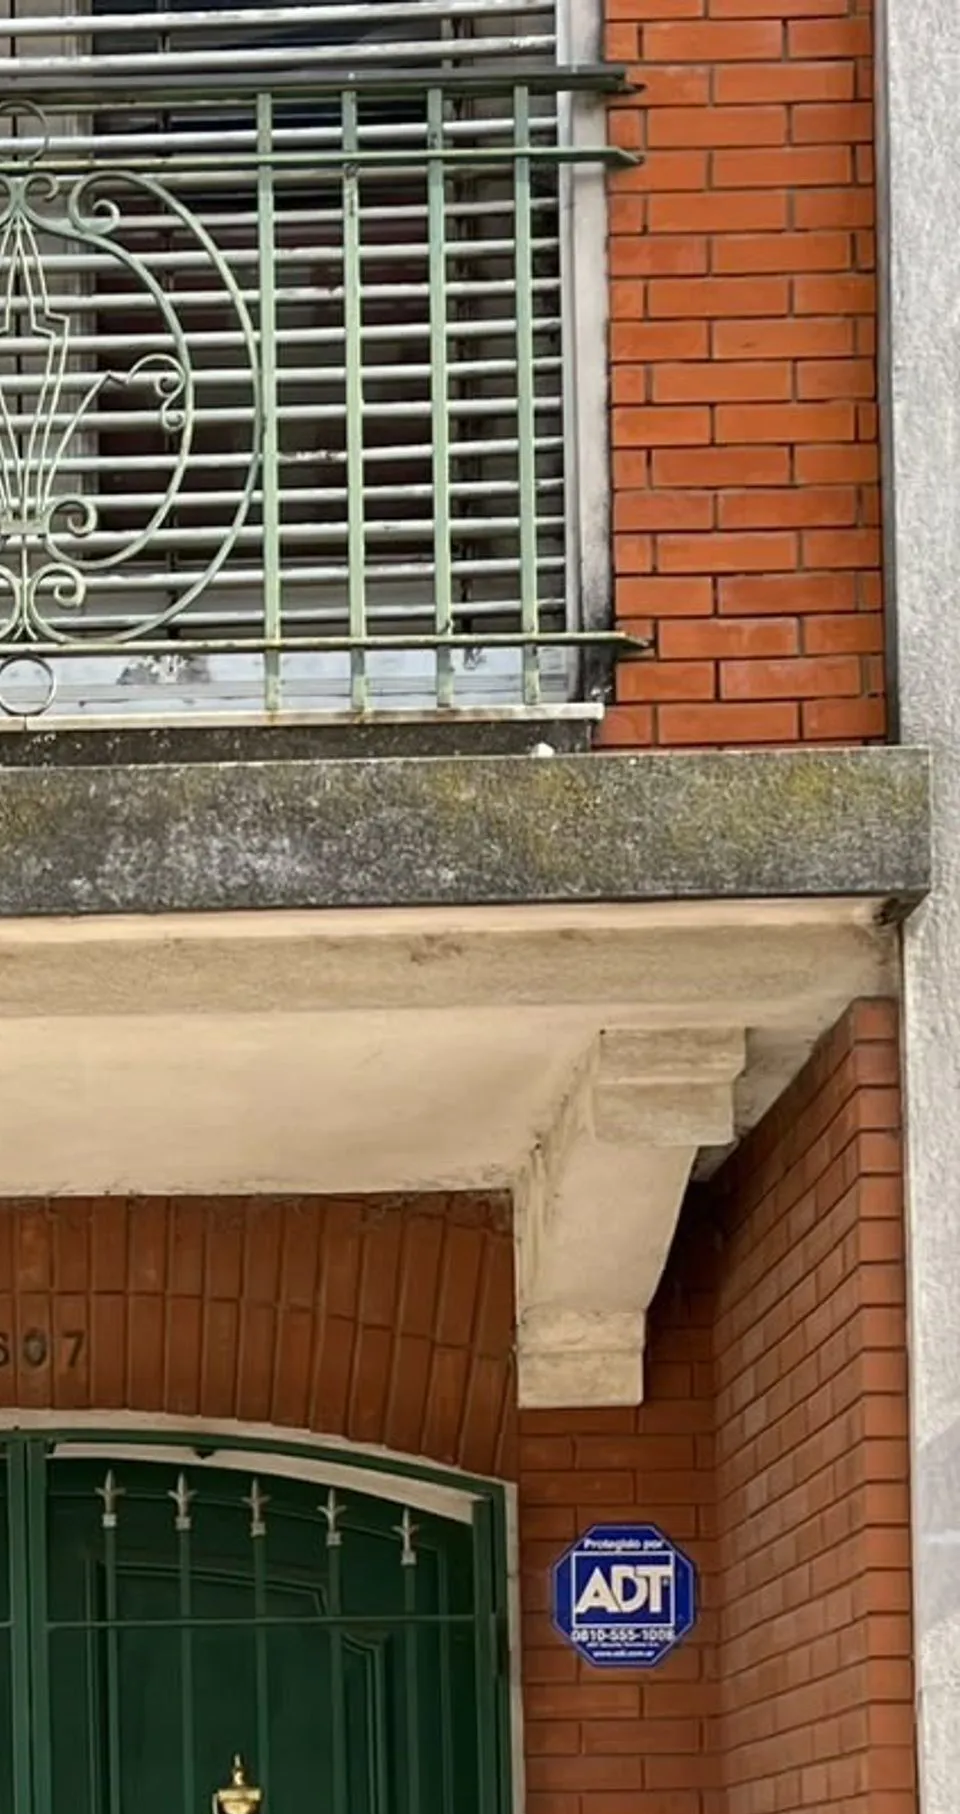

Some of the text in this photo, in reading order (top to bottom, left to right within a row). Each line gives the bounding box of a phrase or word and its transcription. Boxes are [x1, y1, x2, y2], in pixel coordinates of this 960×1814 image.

[584, 1539, 663, 1552] Protegido por
[575, 1565, 673, 1614] ADT
